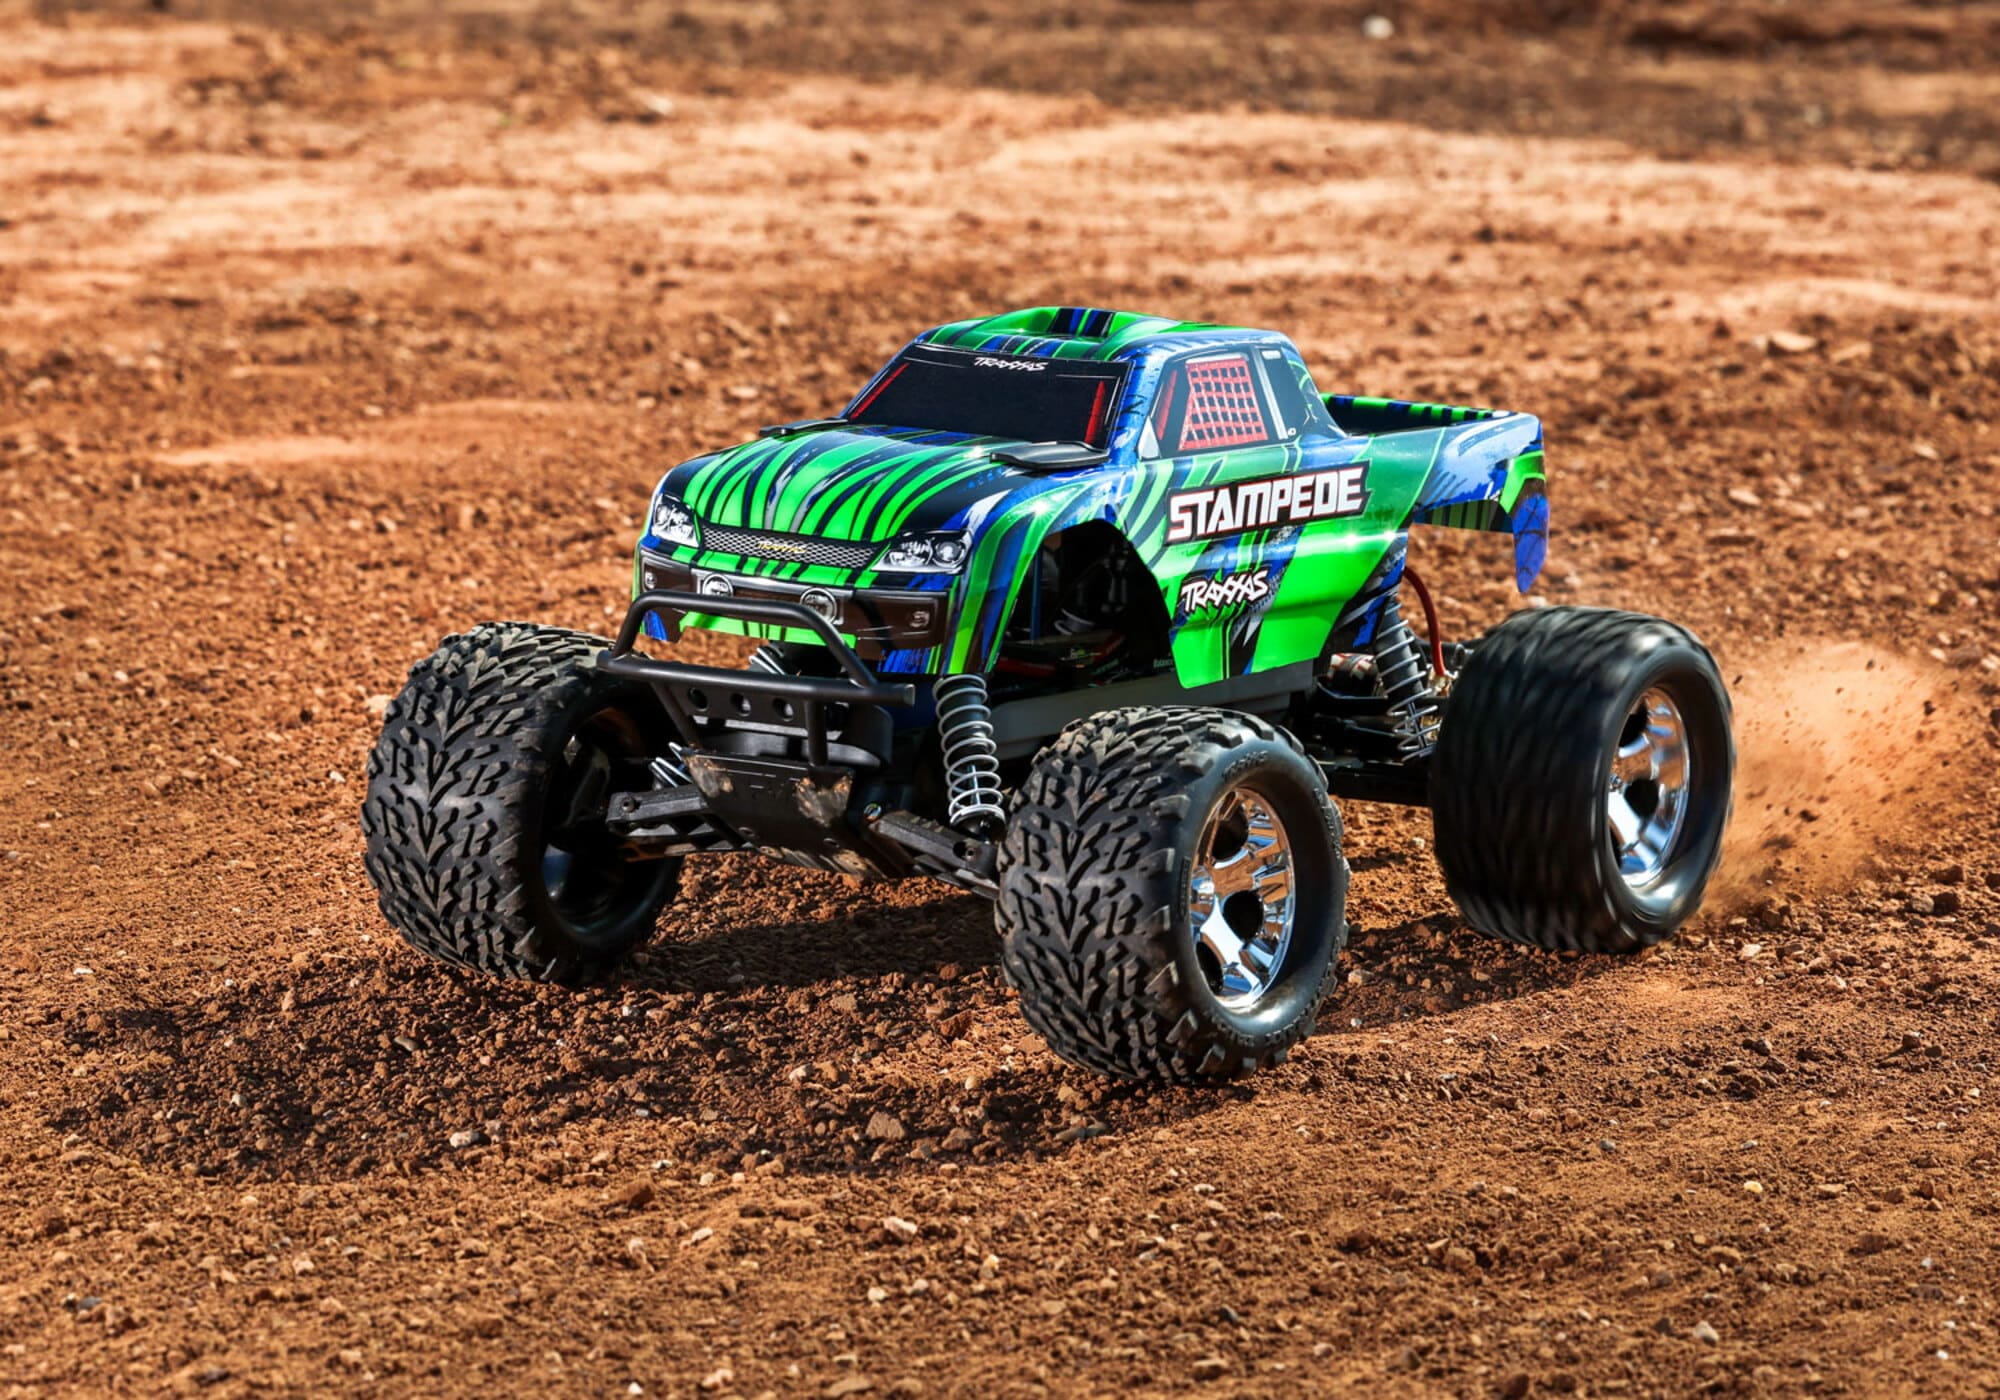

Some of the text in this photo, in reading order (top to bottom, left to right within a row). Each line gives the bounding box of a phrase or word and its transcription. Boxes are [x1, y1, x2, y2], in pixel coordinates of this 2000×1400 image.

[974, 356, 1049, 372] TRAXXAS
[1167, 466, 1364, 542] STAMPEDE
[1180, 569, 1269, 613] TRAXXAS
